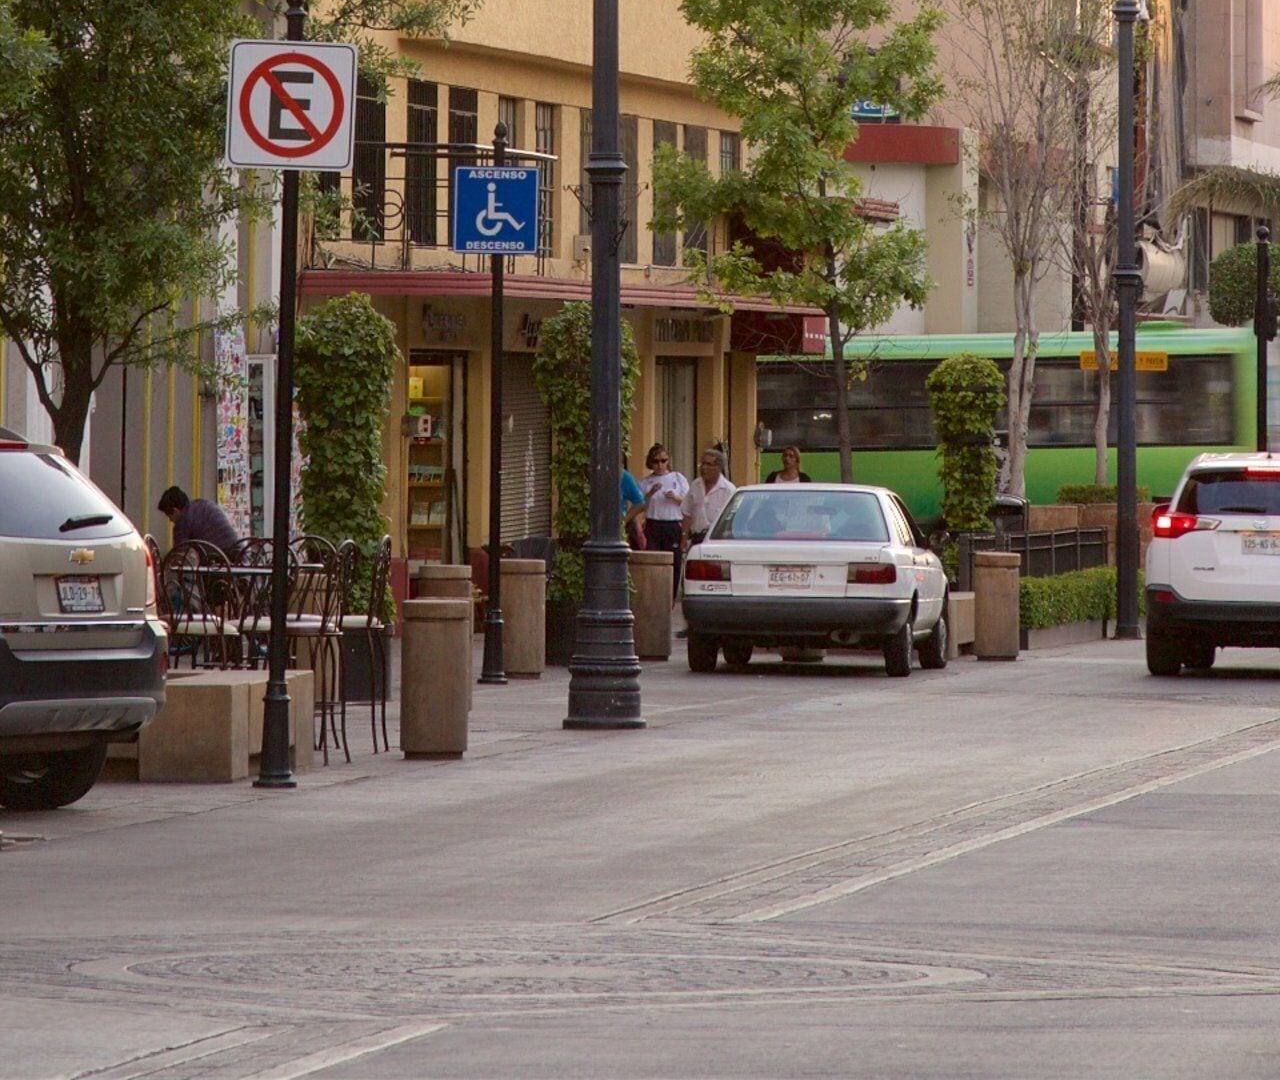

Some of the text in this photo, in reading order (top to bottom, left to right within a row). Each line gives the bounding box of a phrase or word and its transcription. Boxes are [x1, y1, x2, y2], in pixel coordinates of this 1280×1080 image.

[268, 70, 314, 141] E
[469, 170, 527, 180] ASCENSO
[465, 241, 525, 250] DESCENSO
